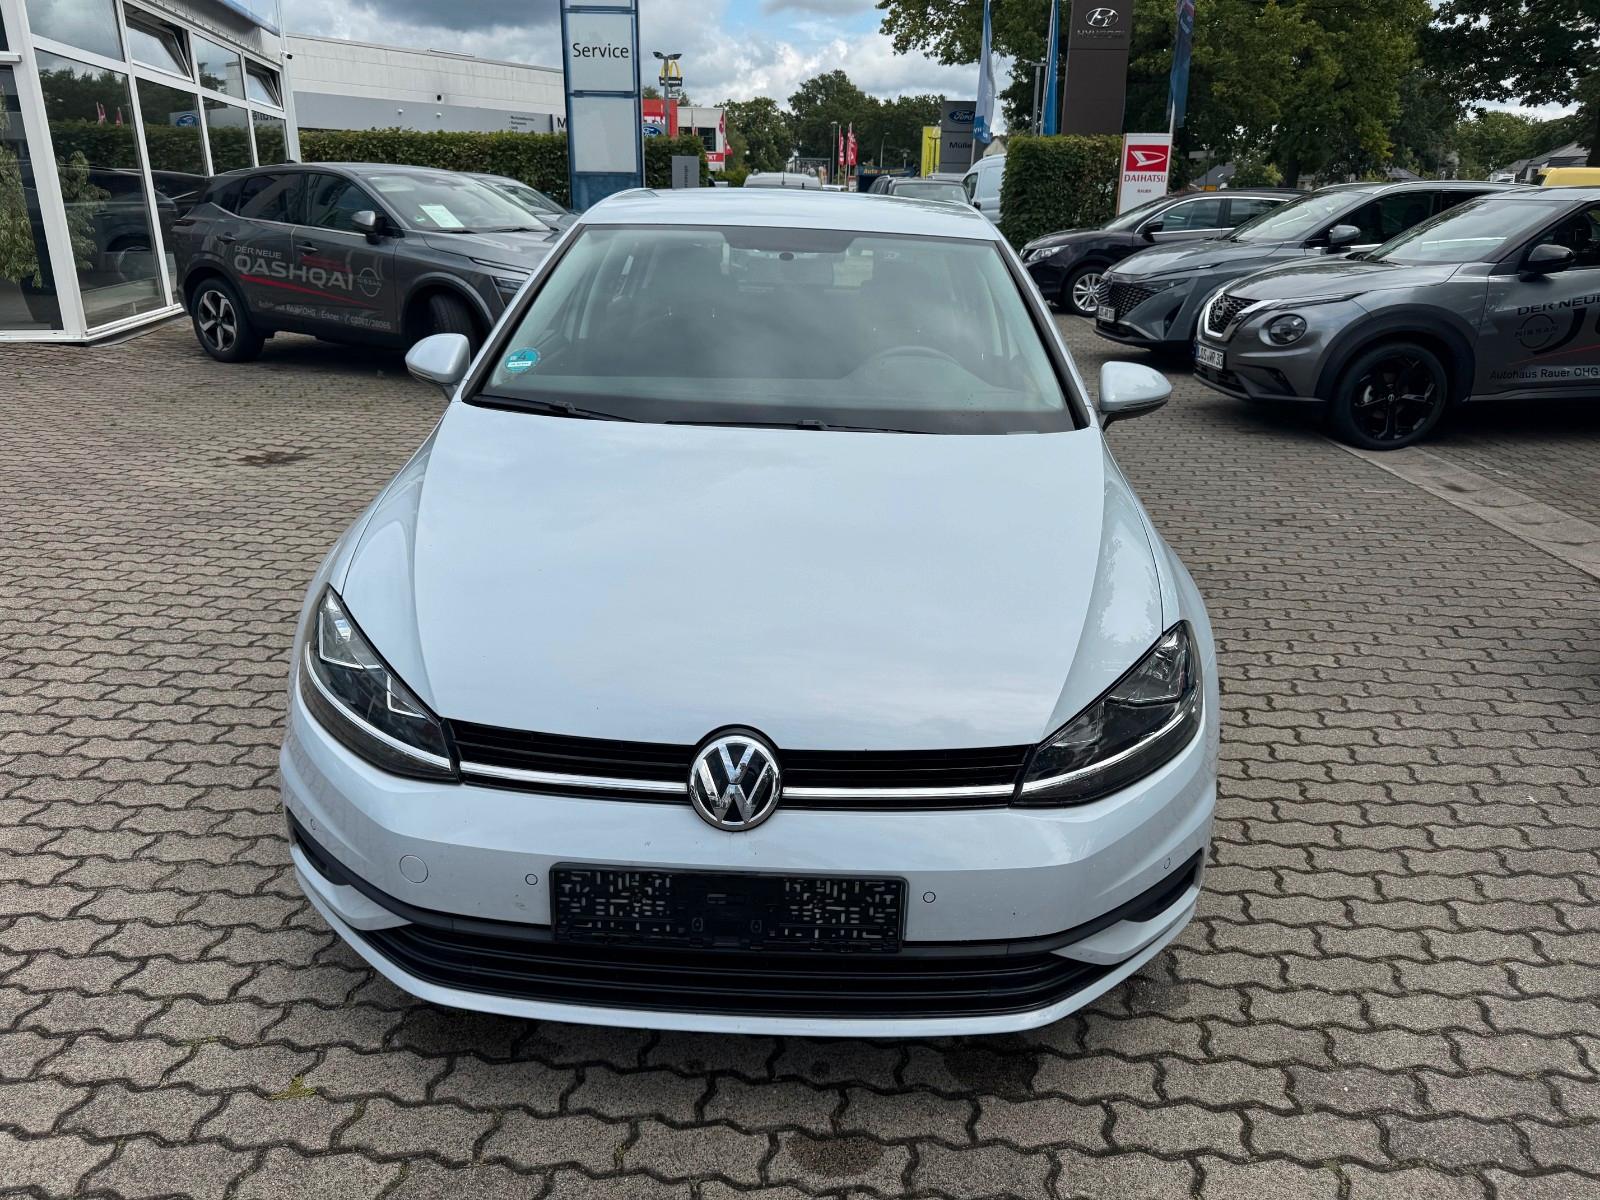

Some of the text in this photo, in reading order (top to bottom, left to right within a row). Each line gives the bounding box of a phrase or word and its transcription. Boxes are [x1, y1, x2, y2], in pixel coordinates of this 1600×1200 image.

[573, 42, 629, 59] Service
[1124, 174, 1166, 183] DAIHATSU
[235, 245, 281, 259] DER NEUE
[234, 255, 353, 291] QASHQAI
[1517, 303, 1553, 316] DER
[1513, 325, 1560, 338] NISSAN
[1489, 367, 1598, 380] Autohaus Rauer OHG
